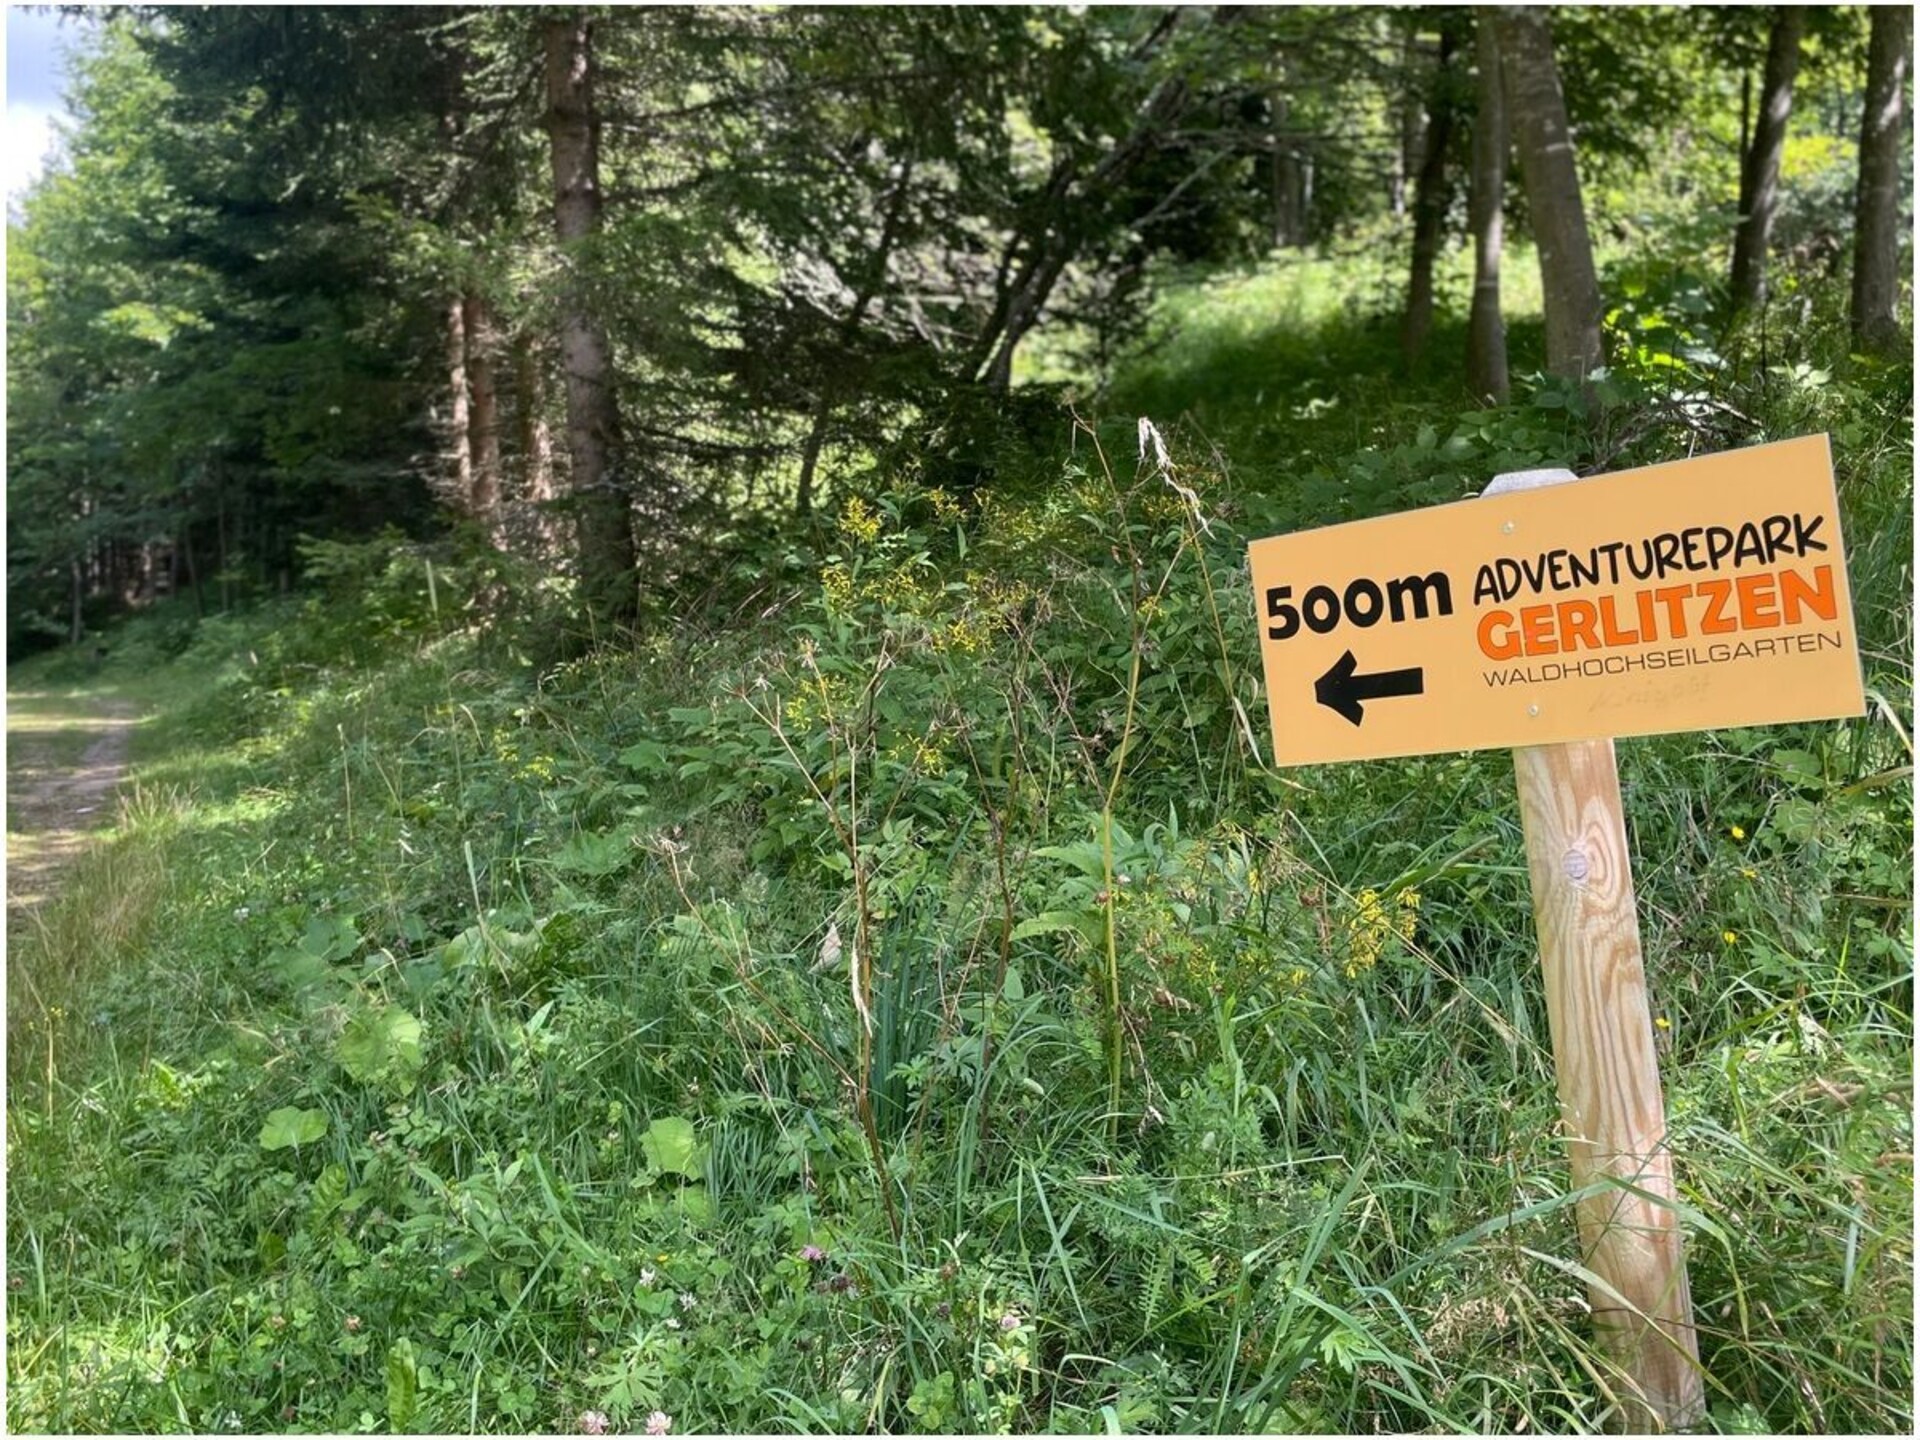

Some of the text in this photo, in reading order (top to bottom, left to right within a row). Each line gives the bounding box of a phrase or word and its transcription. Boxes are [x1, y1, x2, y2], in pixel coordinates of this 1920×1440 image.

[1474, 513, 1828, 604] ADVENTUREPARK
[1267, 571, 1453, 640] 500m
[1476, 564, 1838, 661] GERLITZEN
[1482, 630, 1842, 688] WALDHOCHSEILGARTEN
